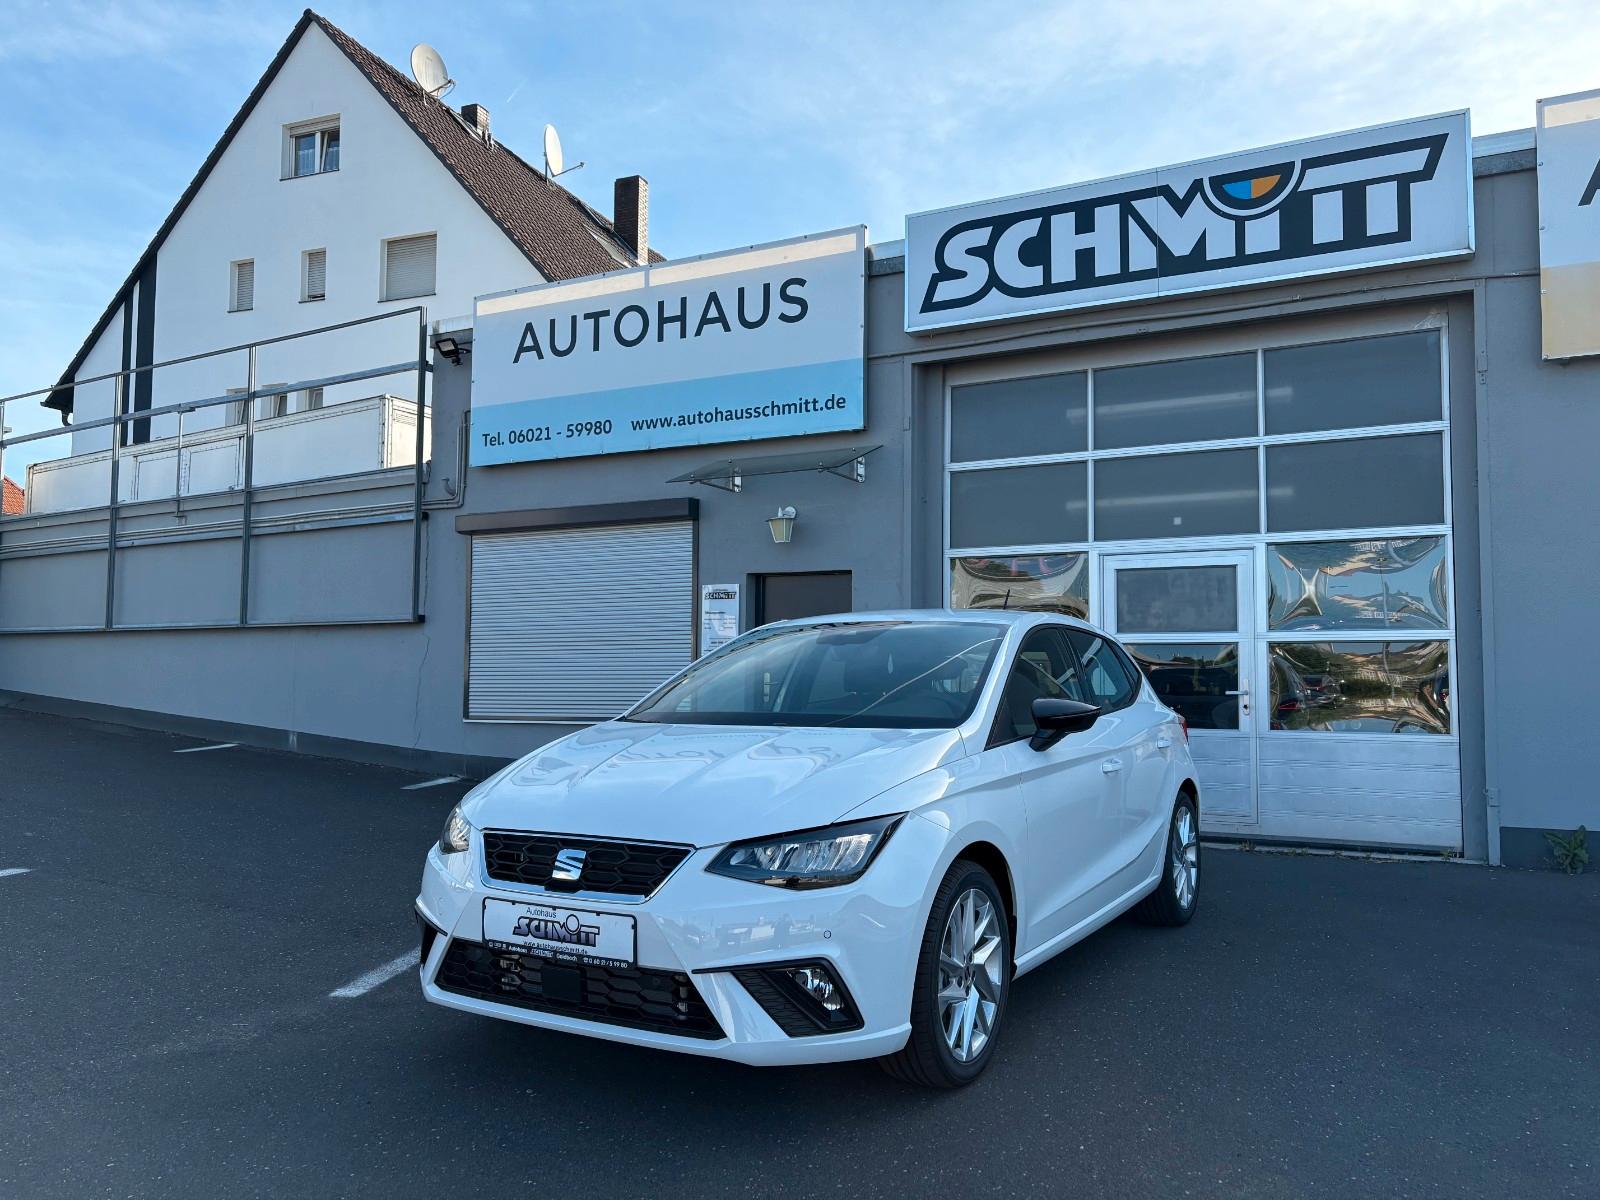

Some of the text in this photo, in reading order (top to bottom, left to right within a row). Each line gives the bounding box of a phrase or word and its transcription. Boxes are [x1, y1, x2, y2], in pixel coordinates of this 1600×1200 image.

[920, 133, 1449, 313] SCHMITT
[512, 277, 809, 364] AUTOHAUS
[631, 394, 846, 430] www.autohausschmitt.de
[482, 432, 505, 447] Tel.
[508, 426, 551, 444] 06021
[566, 419, 612, 438] 59980
[526, 907, 557, 918] Autohaus
